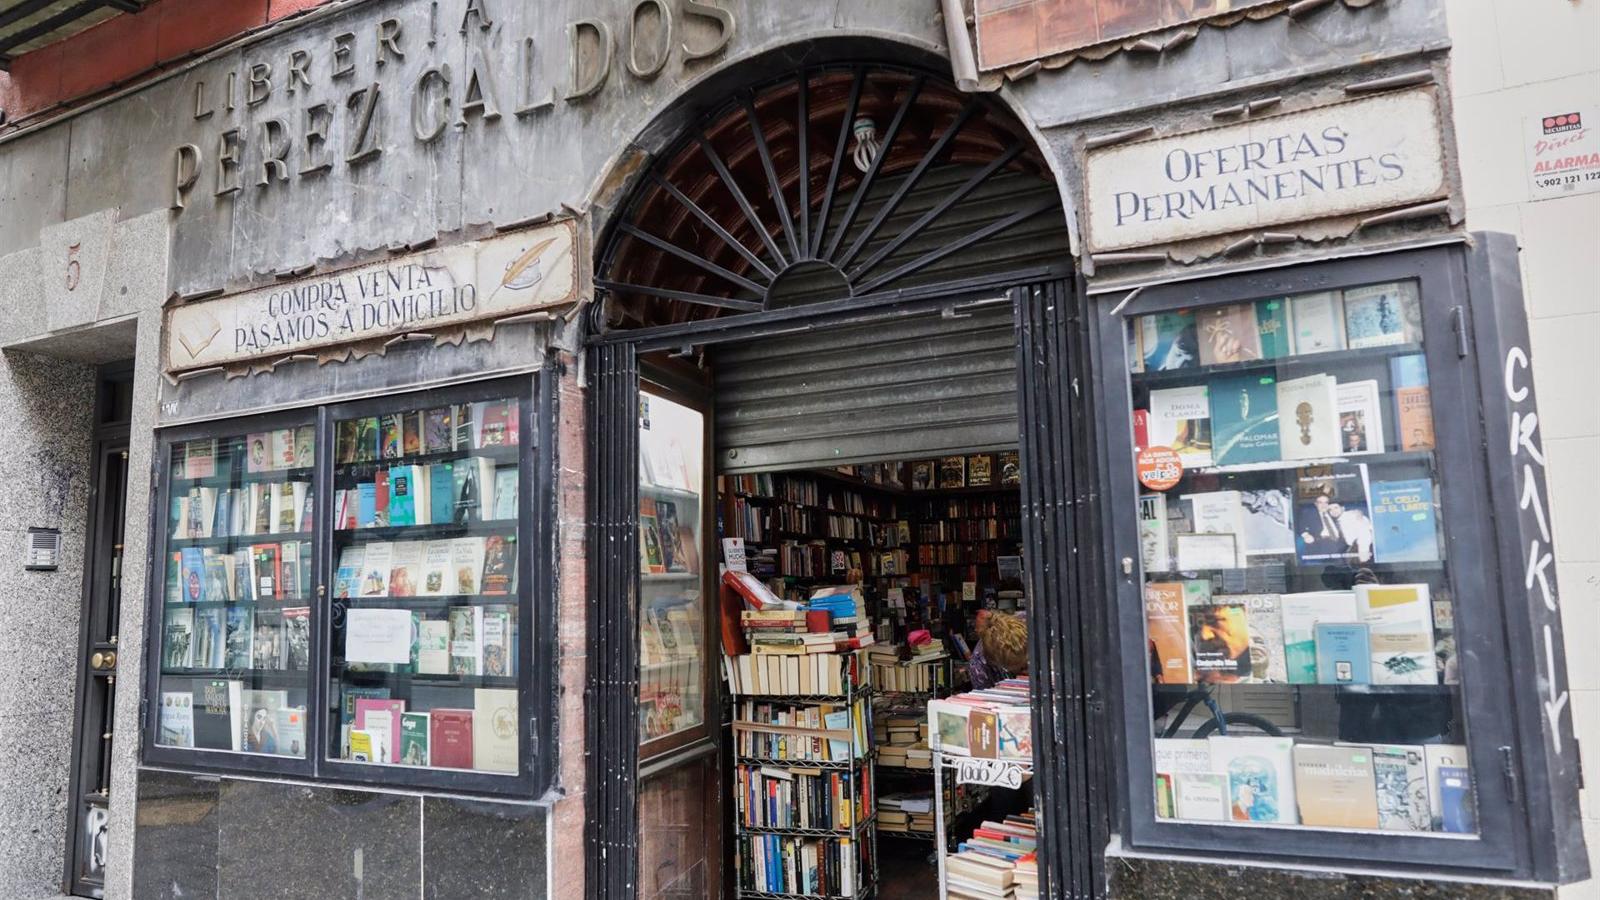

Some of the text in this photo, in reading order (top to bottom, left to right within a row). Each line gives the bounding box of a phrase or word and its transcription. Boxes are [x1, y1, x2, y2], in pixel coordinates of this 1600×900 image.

[171, 0, 738, 209] PEREZ GALDOS
[1544, 124, 1581, 134] SECURITAS
[1535, 128, 1590, 155] Direct
[1543, 178, 1561, 187] 902
[1565, 175, 1580, 184] 121
[65, 243, 81, 292] 5
[268, 264, 432, 318] COMPRA VENTA
[234, 283, 478, 354] PASAMOS A DOMICILIO
